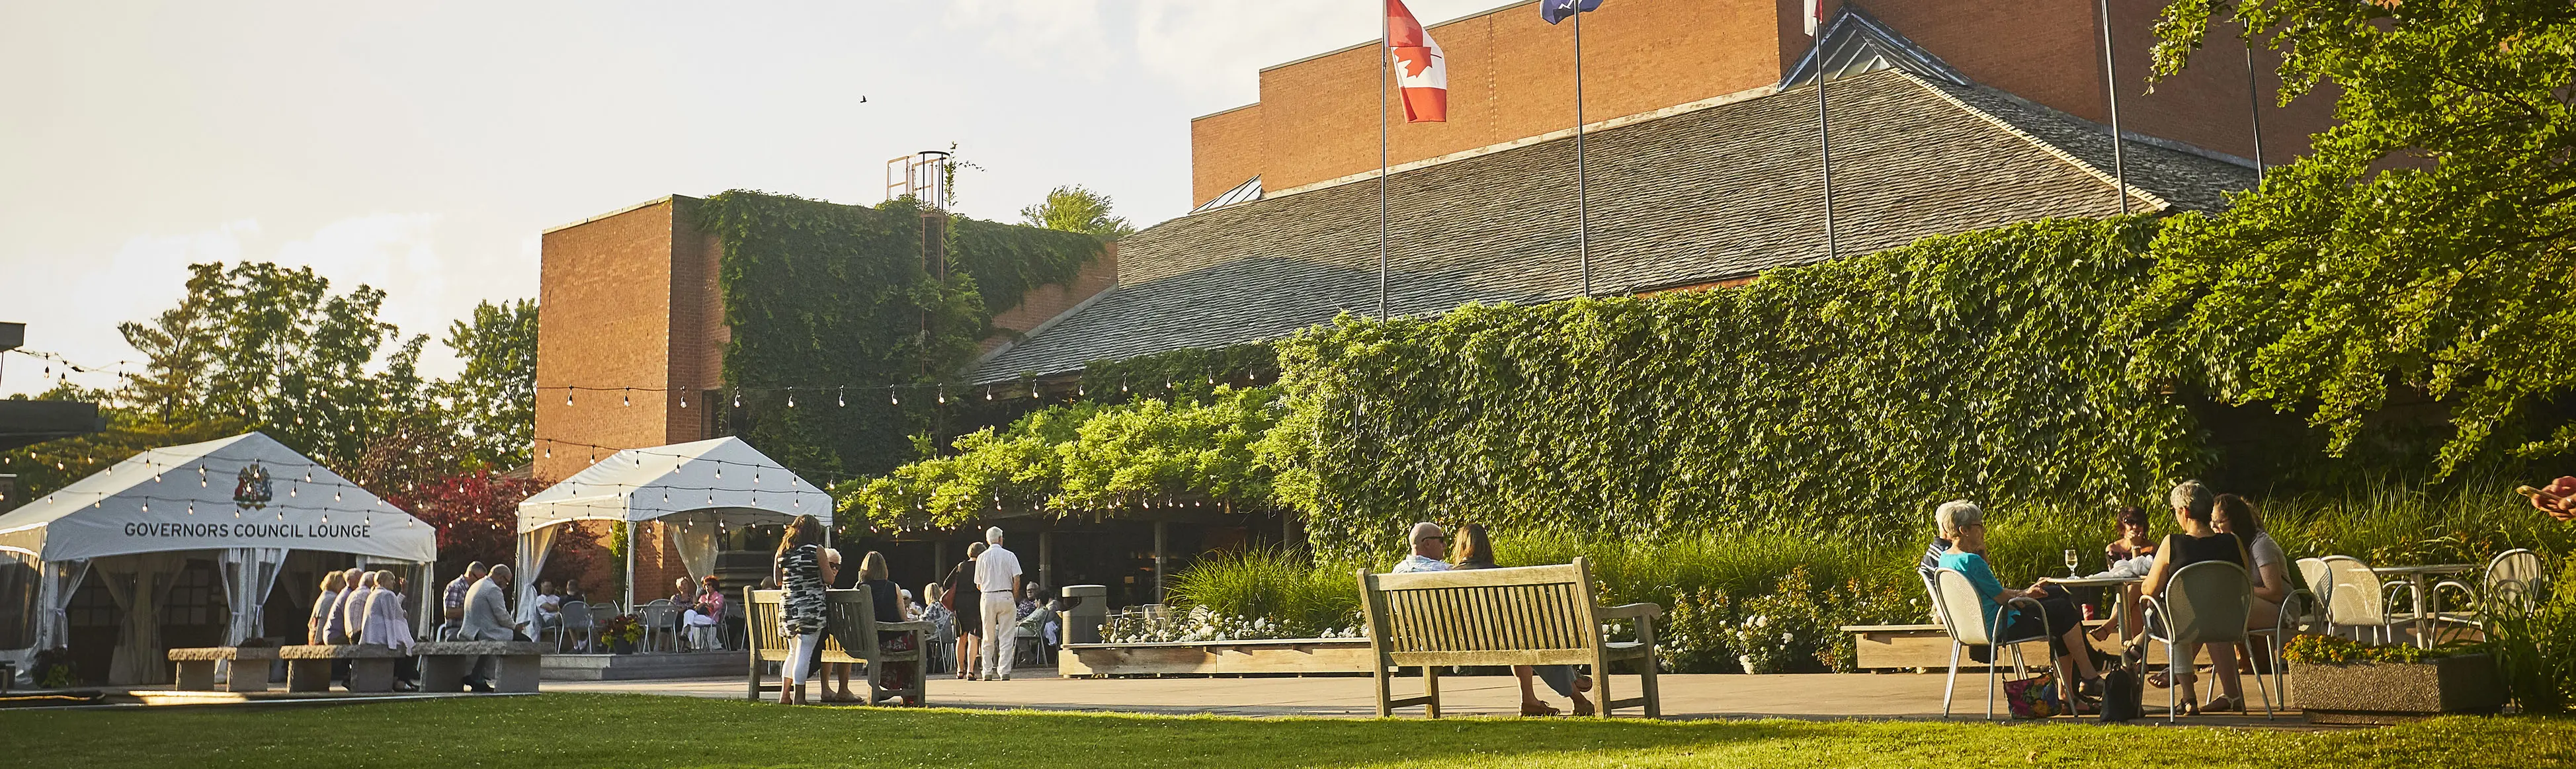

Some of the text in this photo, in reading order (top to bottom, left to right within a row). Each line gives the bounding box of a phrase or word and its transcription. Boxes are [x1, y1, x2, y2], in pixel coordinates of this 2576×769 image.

[125, 522, 370, 538] GOVERNORS COUNCIL LOUNGE
